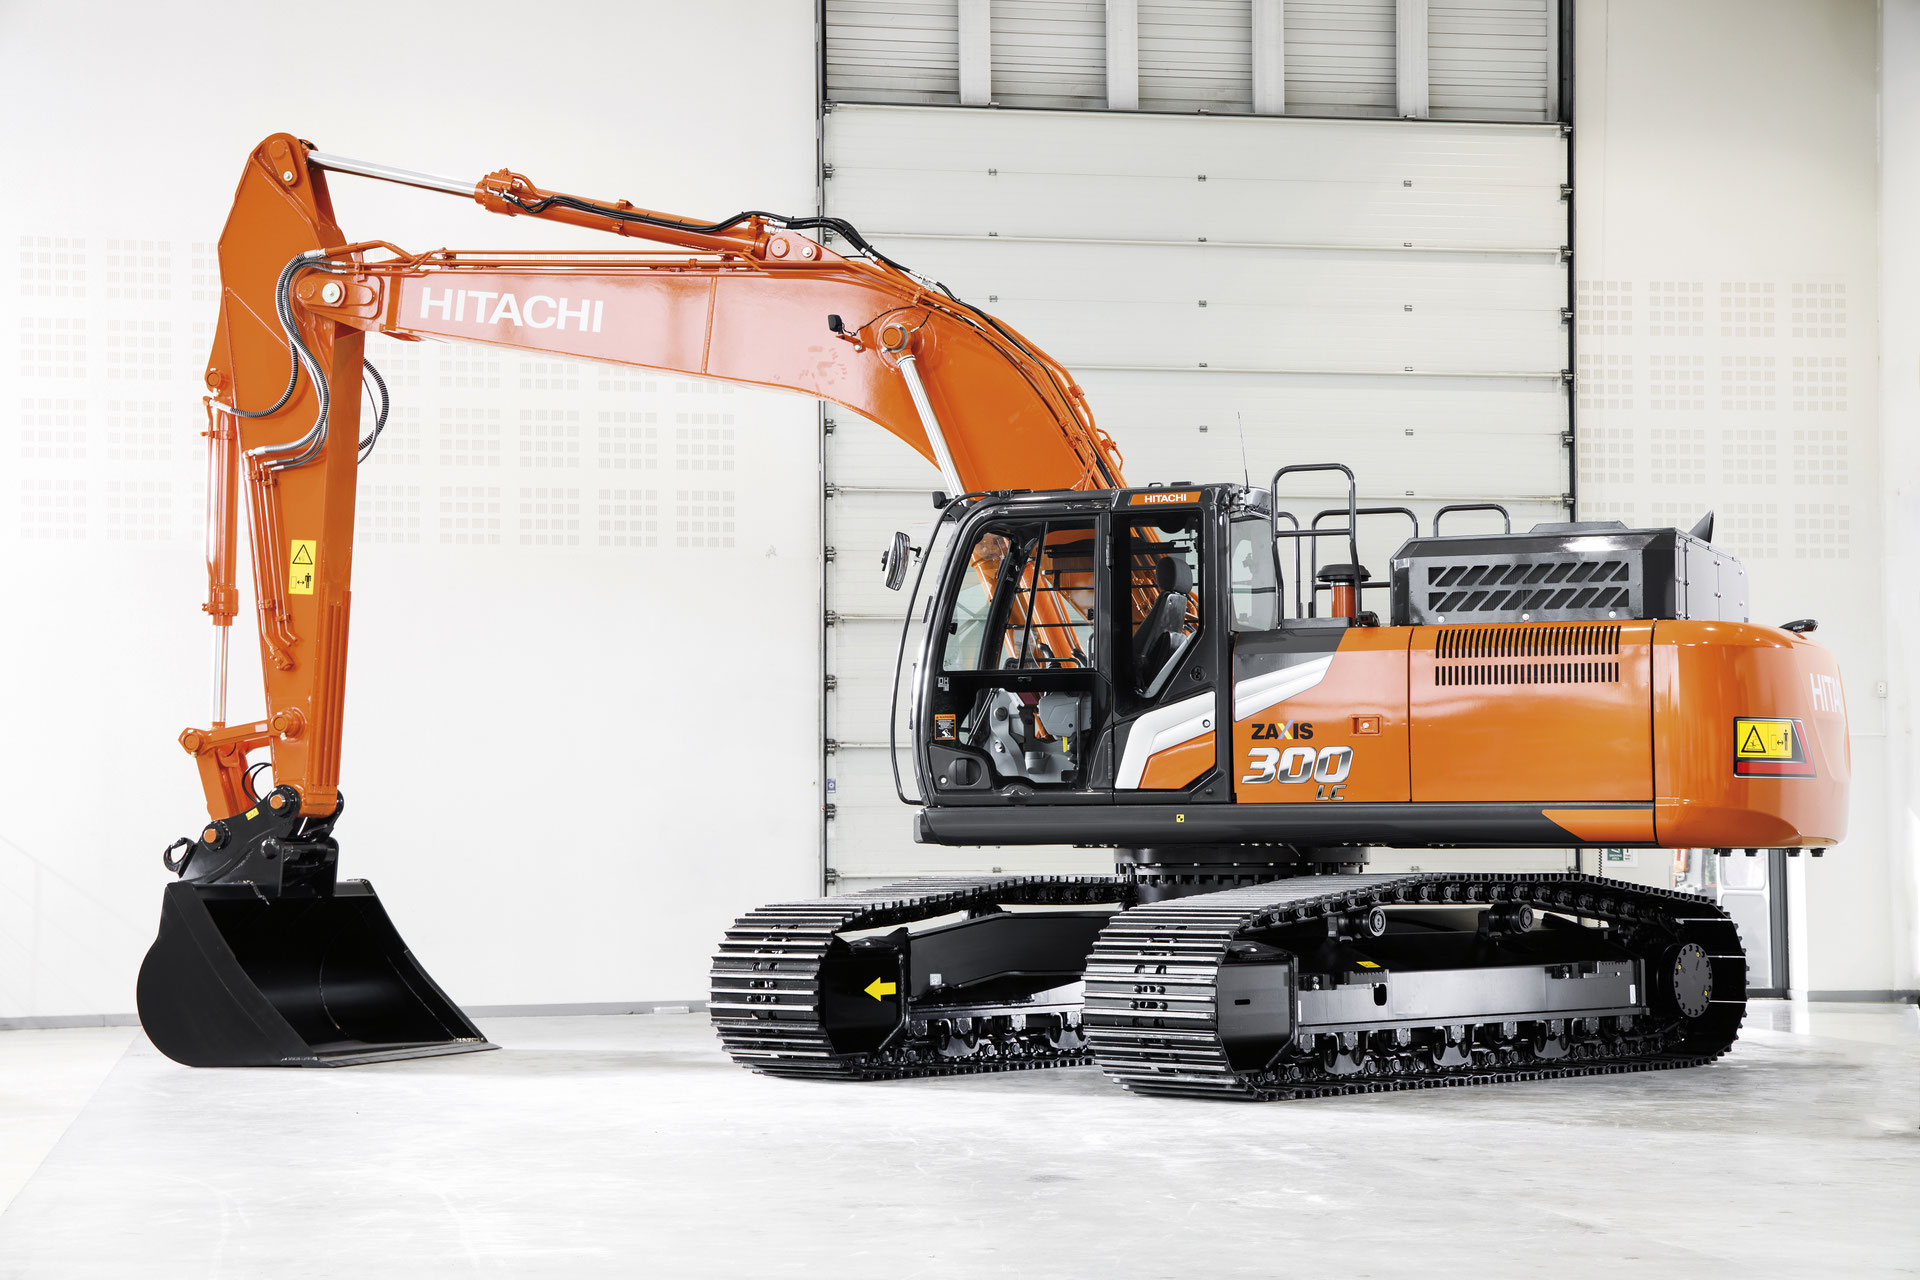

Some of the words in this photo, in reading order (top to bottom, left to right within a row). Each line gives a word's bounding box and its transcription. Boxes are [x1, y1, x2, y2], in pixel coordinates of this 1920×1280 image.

[420, 286, 604, 333] HITACHI
[1144, 493, 1187, 503] HITACHI
[1251, 719, 1314, 740] ZAXIS
[1241, 746, 1354, 784] 300
[1315, 784, 1347, 801] LC
